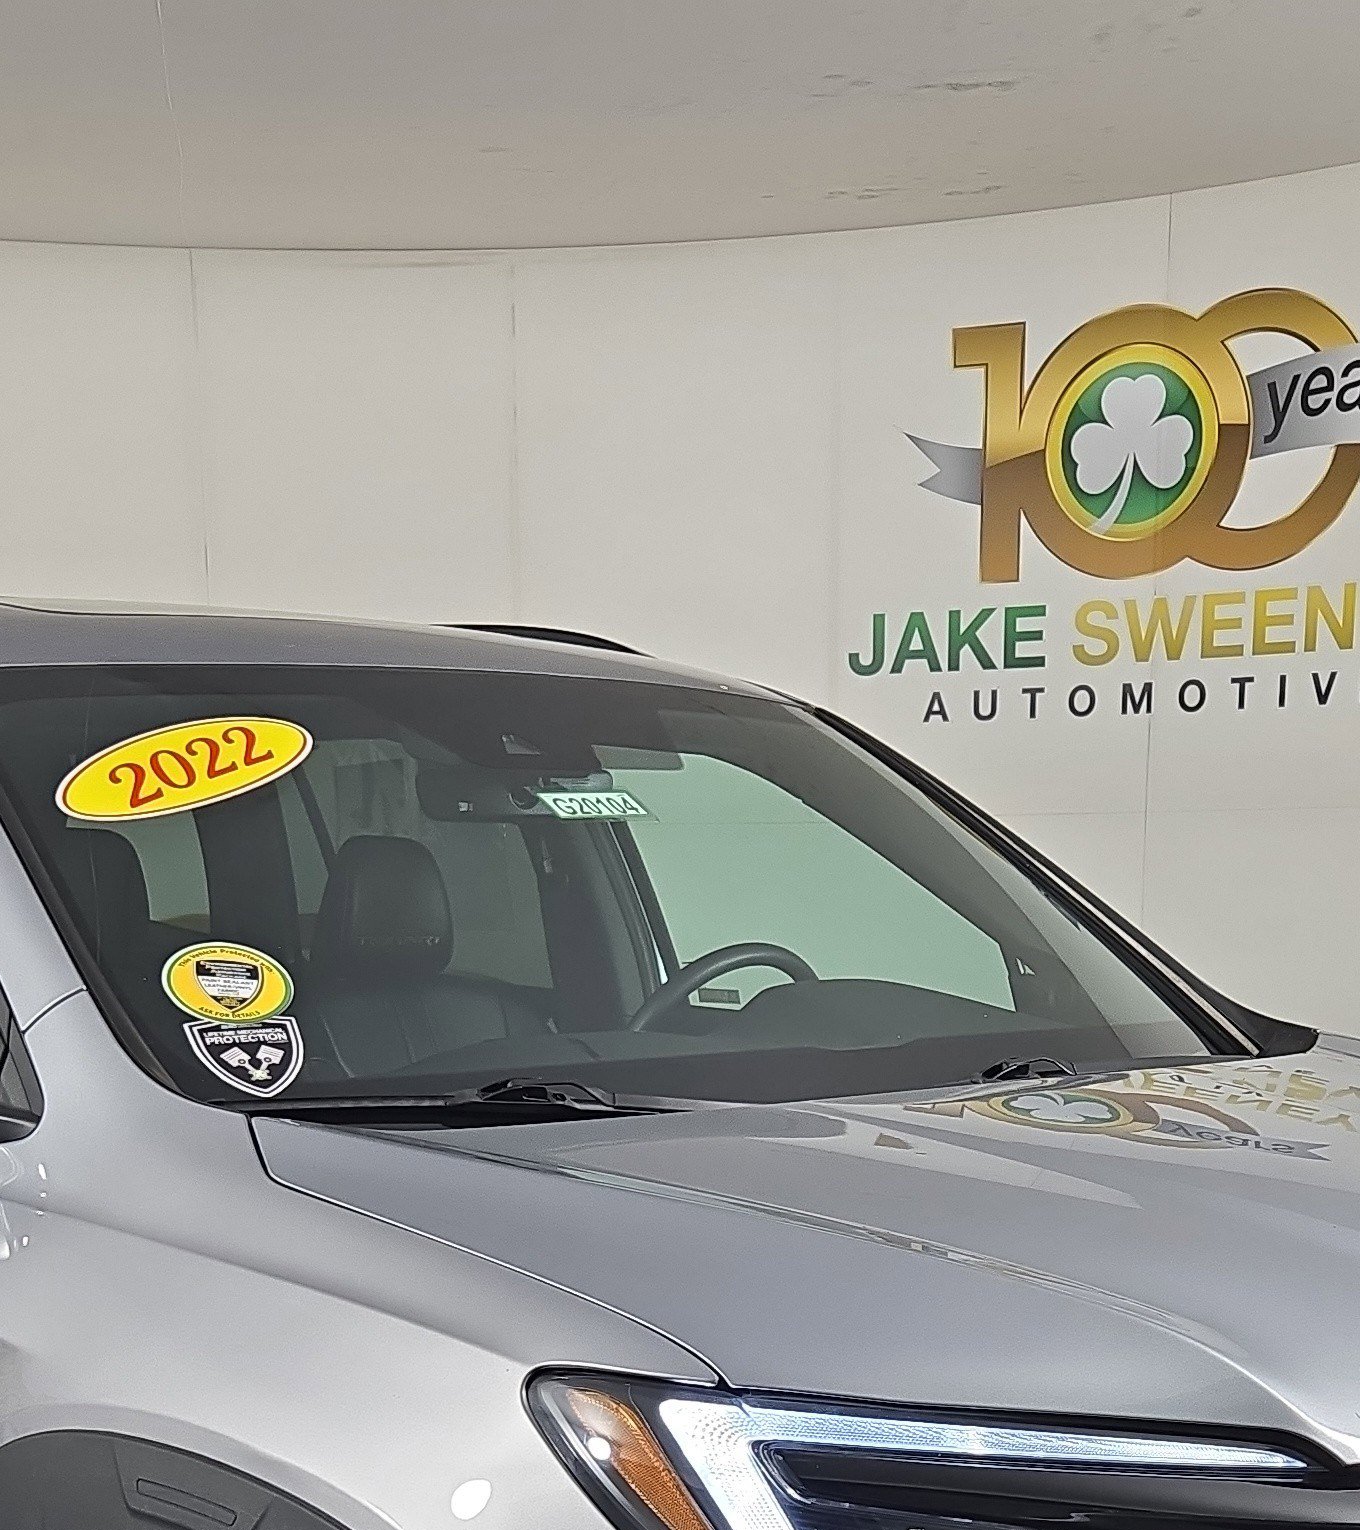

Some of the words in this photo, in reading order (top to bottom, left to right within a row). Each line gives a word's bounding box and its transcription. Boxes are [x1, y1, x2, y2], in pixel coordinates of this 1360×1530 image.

[847, 604, 1048, 677] JAKE
[108, 726, 275, 809] 2022
[552, 797, 640, 815] G20104
[205, 1032, 288, 1046] PROTECTION
